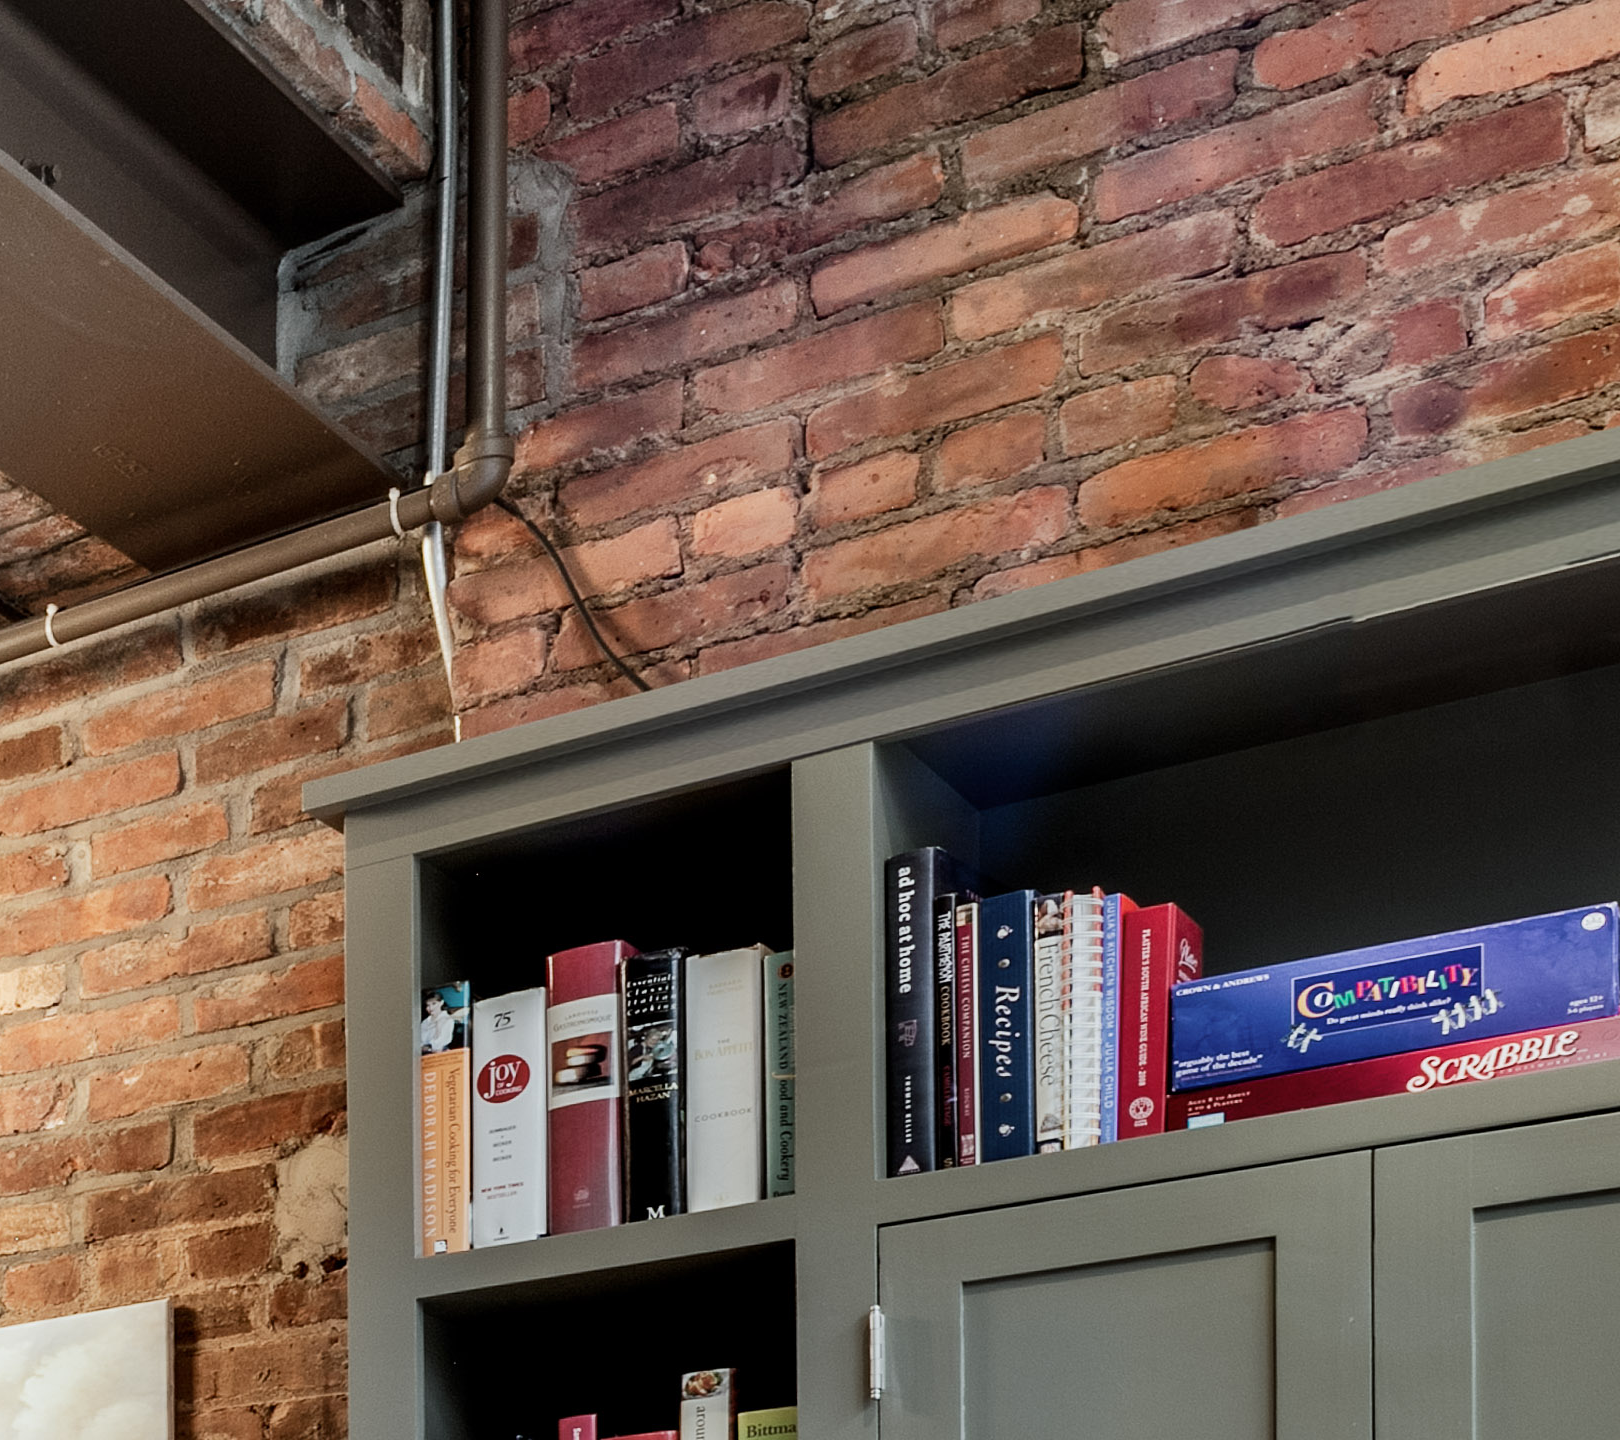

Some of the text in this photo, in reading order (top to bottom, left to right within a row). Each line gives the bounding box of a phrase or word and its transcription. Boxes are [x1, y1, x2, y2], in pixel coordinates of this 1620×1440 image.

[898, 866, 917, 994] ad hoc at home
[937, 910, 953, 1046] THE PARTHENON COOKBOOK
[1104, 900, 1116, 1028] JULIA'S KITCHEN WISDOM
[1175, 984, 1212, 997] CROWN
[1222, 973, 1270, 989] ANDREWS
[1297, 962, 1479, 1019] COMPATIBILITY
[959, 934, 971, 1060] THE CHEESE COMPANION
[1038, 943, 1061, 1087] French Cheese
[1326, 996, 1453, 1026] Do great minds really think alike?
[778, 982, 791, 1070] NEW ZEALAND
[988, 985, 1021, 1078] Recipes
[483, 1060, 522, 1100] joy
[628, 1081, 679, 1097] MARCELLA
[1103, 1042, 1115, 1109] JULIA CHILD
[1173, 1050, 1250, 1071] "arguably the best
[1175, 1066, 1200, 1079] game
[1200, 1062, 1212, 1073] of
[1212, 1060, 1226, 1071] the
[1406, 1030, 1580, 1093] SCRABBLE
[495, 1085, 523, 1097] COOKING
[636, 1091, 672, 1103] HAZAN
[694, 1106, 753, 1123] COOKBOOK
[779, 1104, 795, 1127] and
[904, 1075, 912, 1144] THOMAS KELLER
[424, 1071, 437, 1238] DEBORAH MADISON
[445, 1067, 461, 1233] Vegetarian Cooking for Everyone
[776, 1131, 794, 1181] Cookery
[646, 1205, 666, 1221] M
